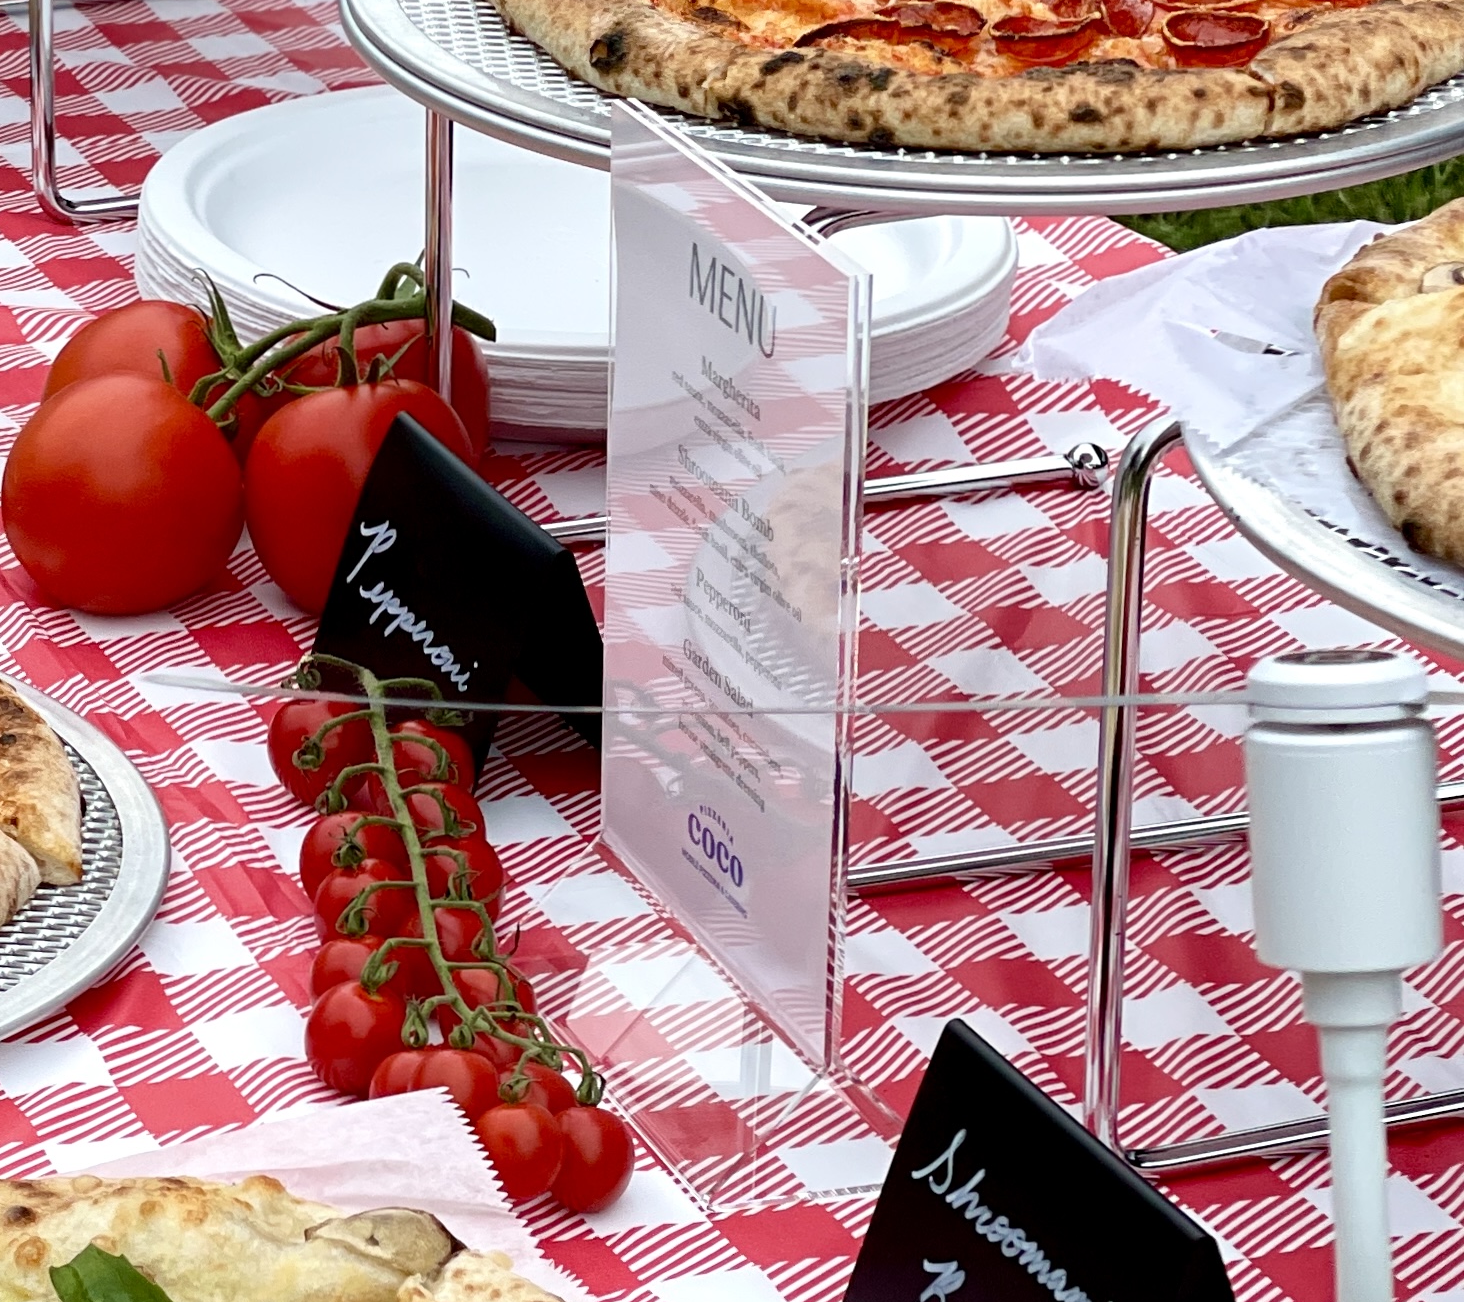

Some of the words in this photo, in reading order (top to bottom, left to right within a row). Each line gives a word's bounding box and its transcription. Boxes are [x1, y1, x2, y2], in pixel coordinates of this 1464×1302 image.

[689, 241, 777, 359] MENU
[700, 354, 761, 422] Margherita
[742, 497, 775, 542] Bomb
[345, 519, 480, 693] Pepperoni
[696, 565, 752, 634] Pepperoni
[683, 638, 722, 689] Garden
[723, 675, 753, 719] Salad
[687, 812, 744, 888] COCO
